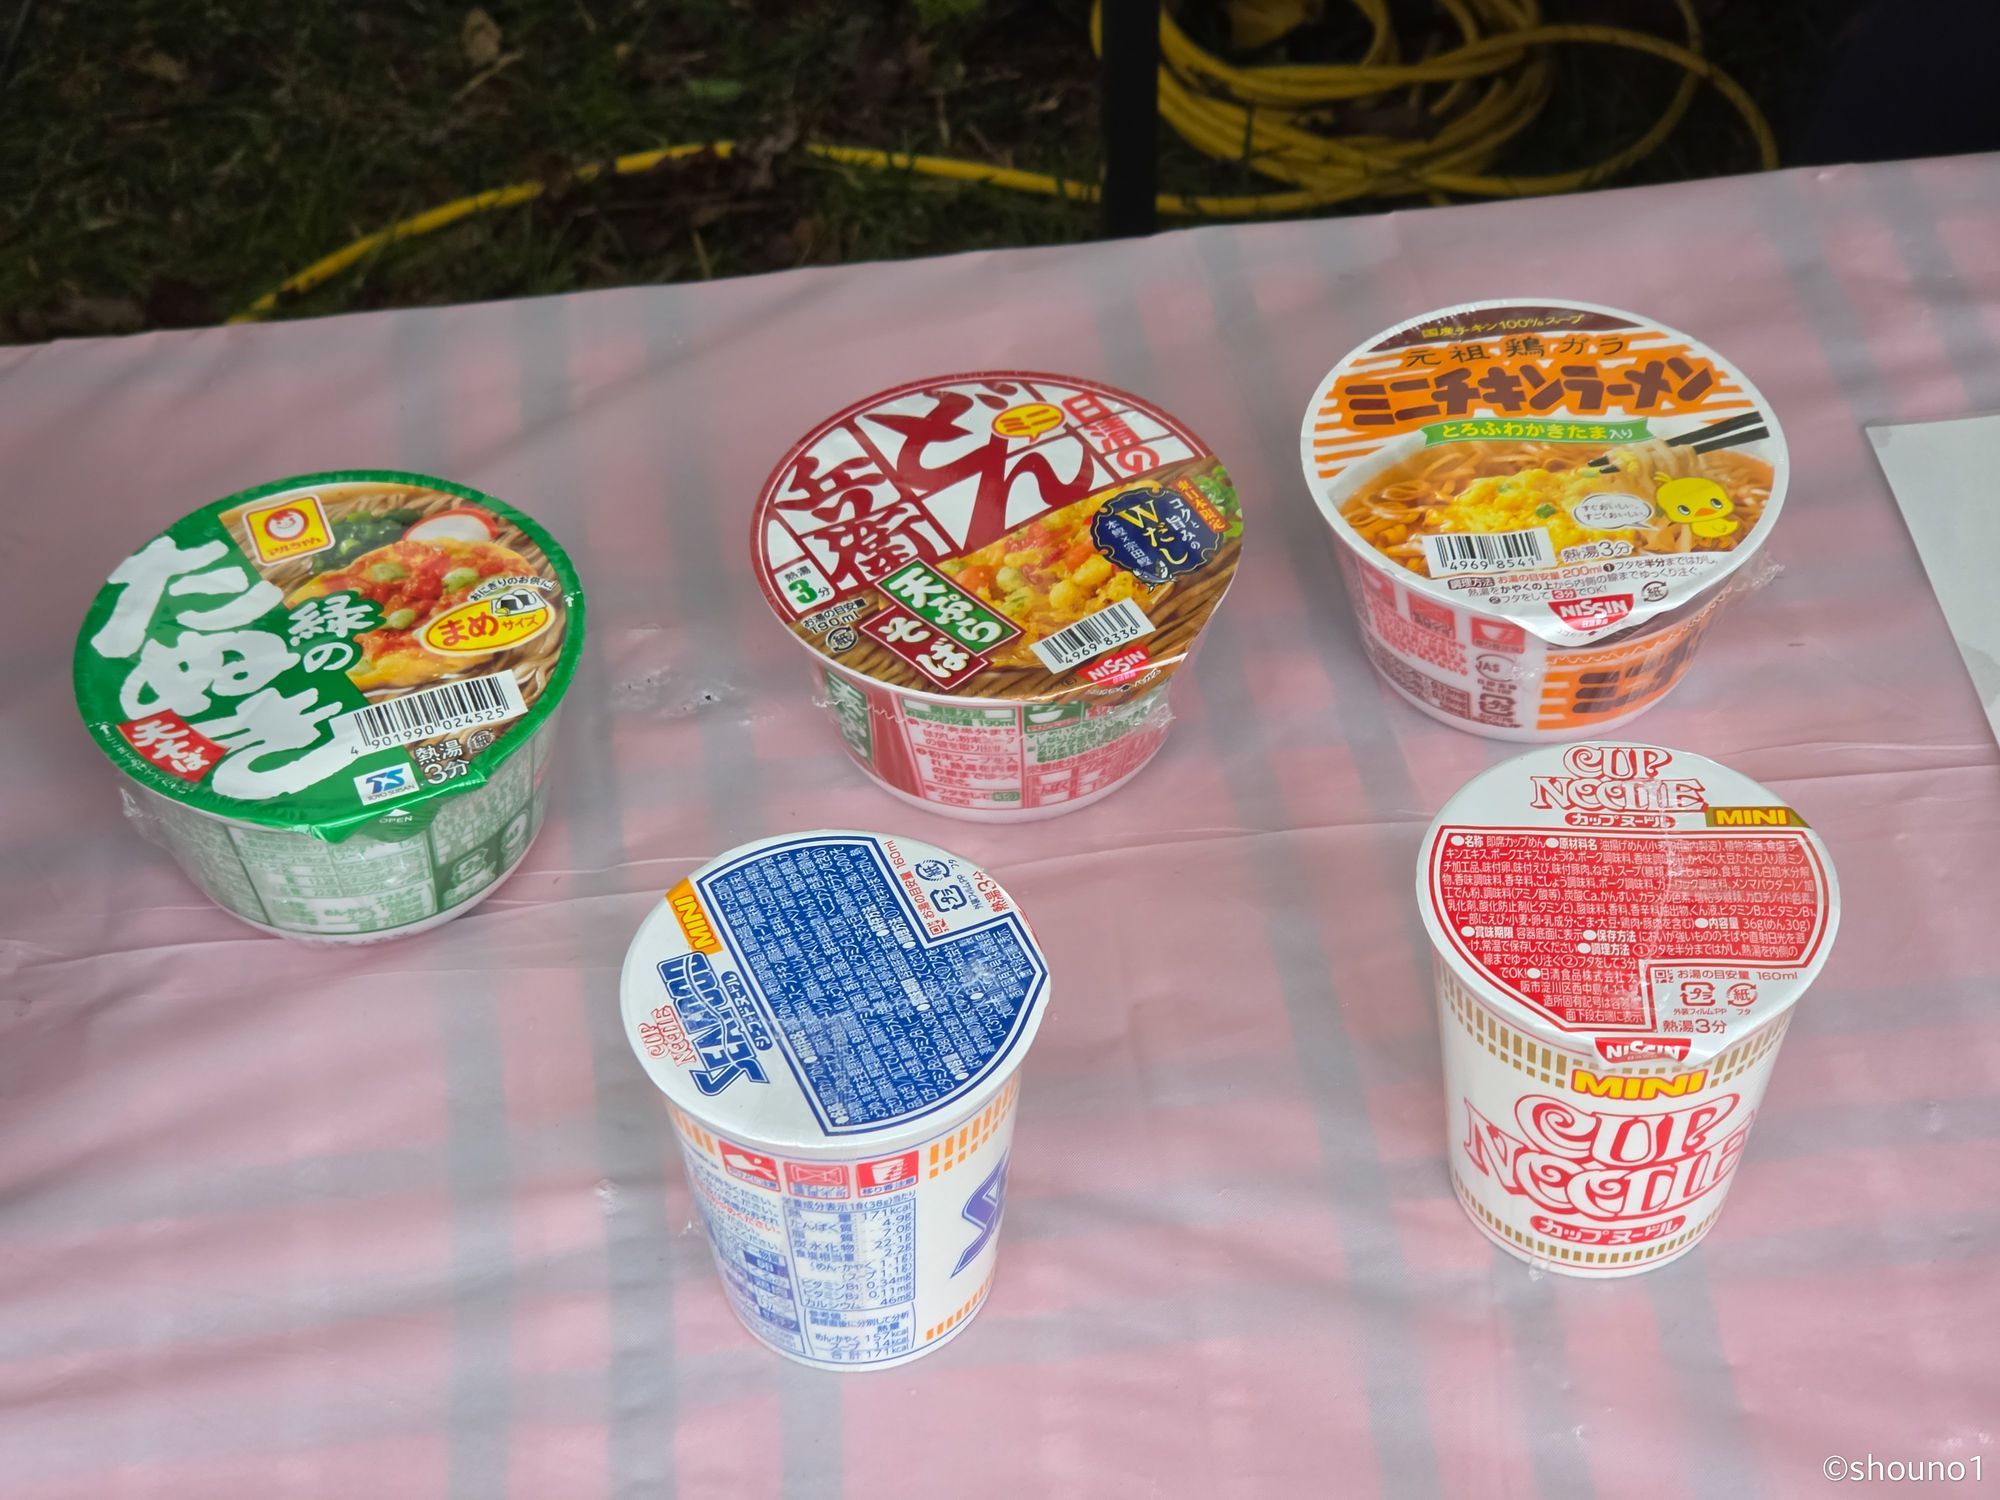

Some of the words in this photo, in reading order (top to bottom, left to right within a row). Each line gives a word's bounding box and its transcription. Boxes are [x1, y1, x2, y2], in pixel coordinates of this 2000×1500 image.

[1421, 314, 1585, 339] 国産チキン100%スープ
[1406, 336, 1624, 367] 元祖鶏ガラ
[1344, 356, 1713, 426] ミニチキンラーメン
[999, 407, 1060, 433] ミニ
[1442, 421, 1633, 441] とろふわかきたま入り
[1115, 499, 1189, 565] Wだし
[1450, 559, 1489, 571] 4969
[1496, 557, 1536, 569] 8541
[1563, 541, 1632, 563] 熱湯3分
[889, 567, 1002, 643] 天ぷら
[1559, 599, 1629, 619] NISSIN
[288, 594, 375, 673] 緑の
[437, 611, 499, 647] まめ
[502, 614, 540, 631] サイズ
[810, 610, 860, 635] 190ml
[878, 616, 970, 679] そば
[1065, 642, 1098, 665] 4969
[1103, 626, 1138, 646] 8336
[90, 535, 344, 801] たぬき
[1087, 650, 1147, 682] NISSIN
[372, 725, 435, 749] 901990
[442, 707, 505, 730] 024525
[415, 738, 463, 765] 熱湯
[1563, 745, 1673, 782] CUP
[424, 759, 470, 785] 3分
[1529, 776, 1710, 814] NOODLE
[379, 815, 413, 824] OPEN
[1571, 812, 1672, 830] カップヌードル
[1715, 808, 1788, 827] MINI
[883, 839, 906, 868] 160ml
[674, 895, 716, 950] MINI
[1677, 969, 1750, 980] お湯の目安量
[1757, 971, 1798, 981] 160ml
[635, 1016, 670, 1060] CUP
[648, 1004, 697, 1068] NOODLE
[656, 950, 770, 1097] SEAFOOD
[1663, 1017, 1727, 1035] 熱湯3分
[1571, 1068, 1709, 1102] MINI
[1513, 1093, 1742, 1170] CUP
[1462, 1094, 1757, 1223] NOODLE
[1538, 1217, 1680, 1246] カップヌードル
